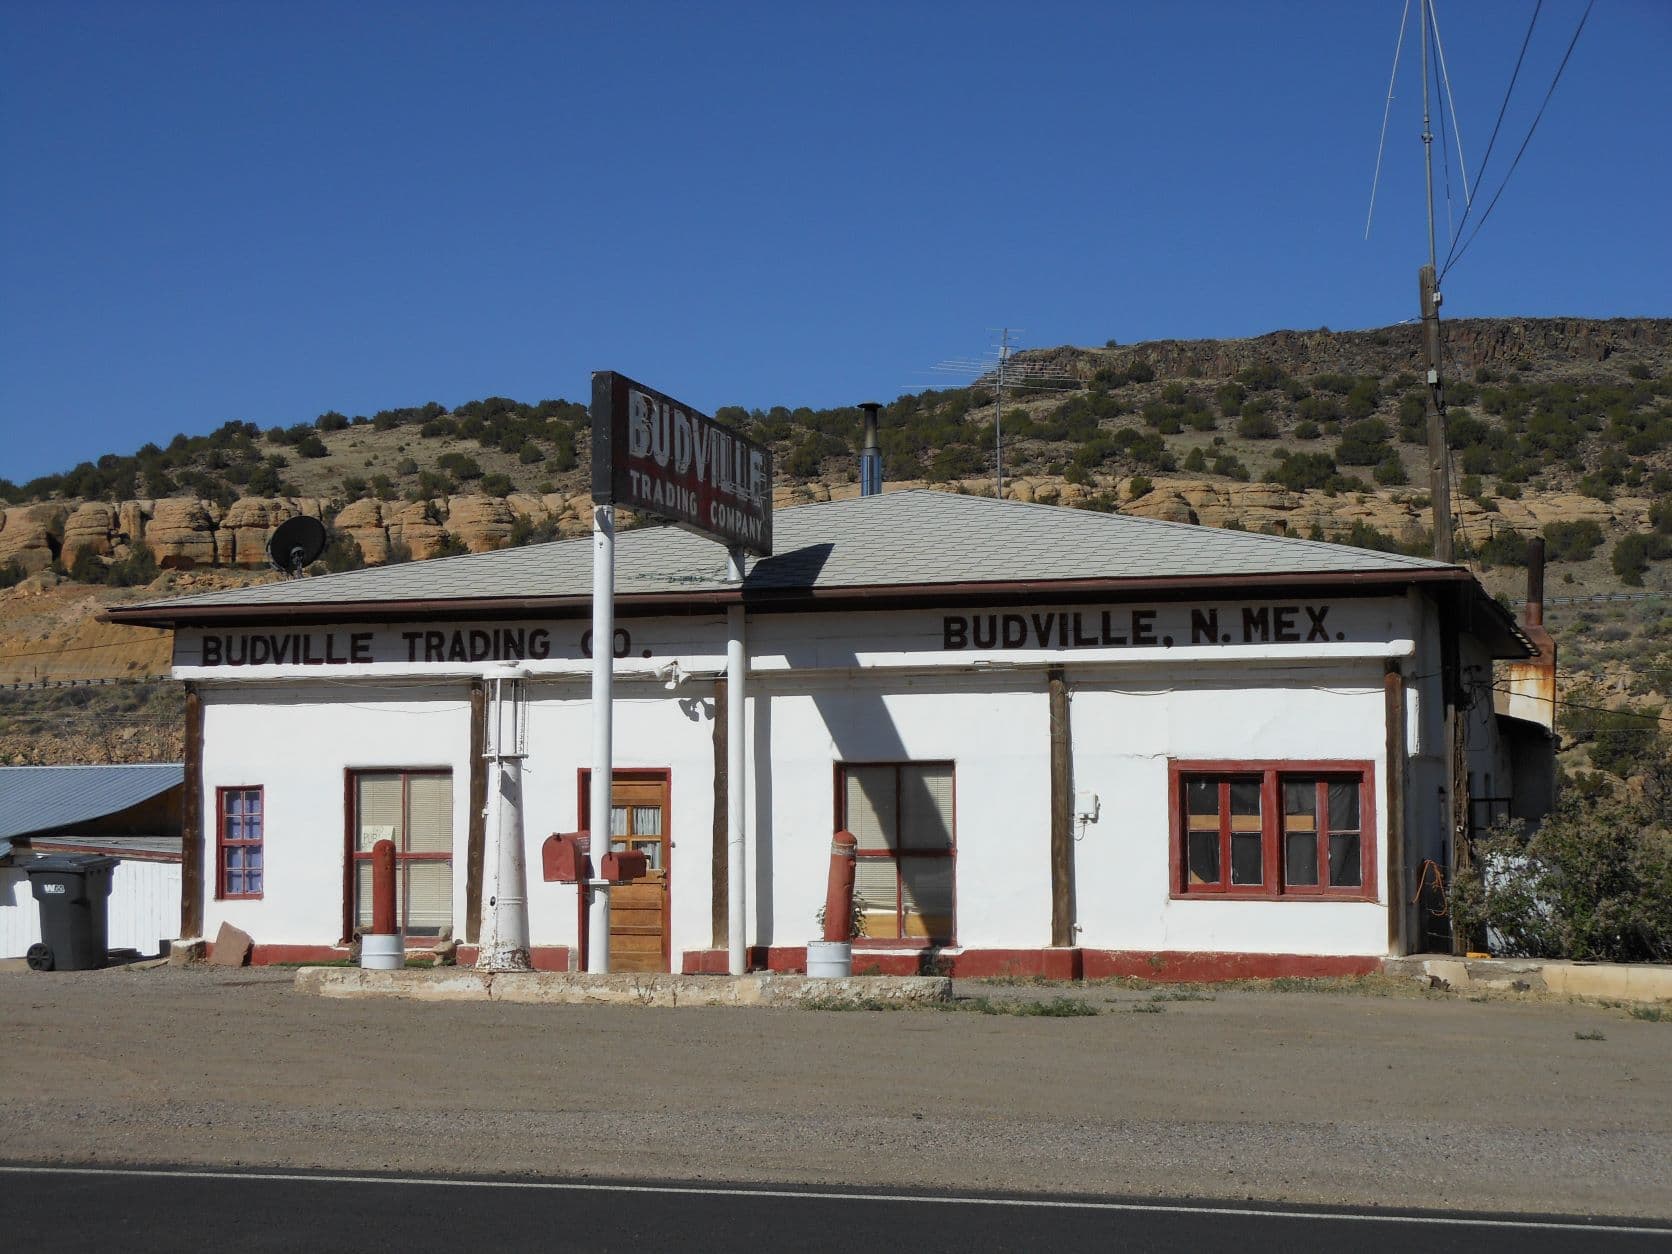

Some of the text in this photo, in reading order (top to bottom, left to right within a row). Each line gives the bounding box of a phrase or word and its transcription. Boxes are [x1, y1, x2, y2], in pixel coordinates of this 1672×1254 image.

[629, 390, 767, 508] BUDVILLE
[629, 469, 763, 541] TRADING COMPANY
[202, 632, 374, 666] BUDVILLE
[402, 628, 551, 662] TRADING
[943, 605, 1346, 650] BUDVILLE, N. MEX.
